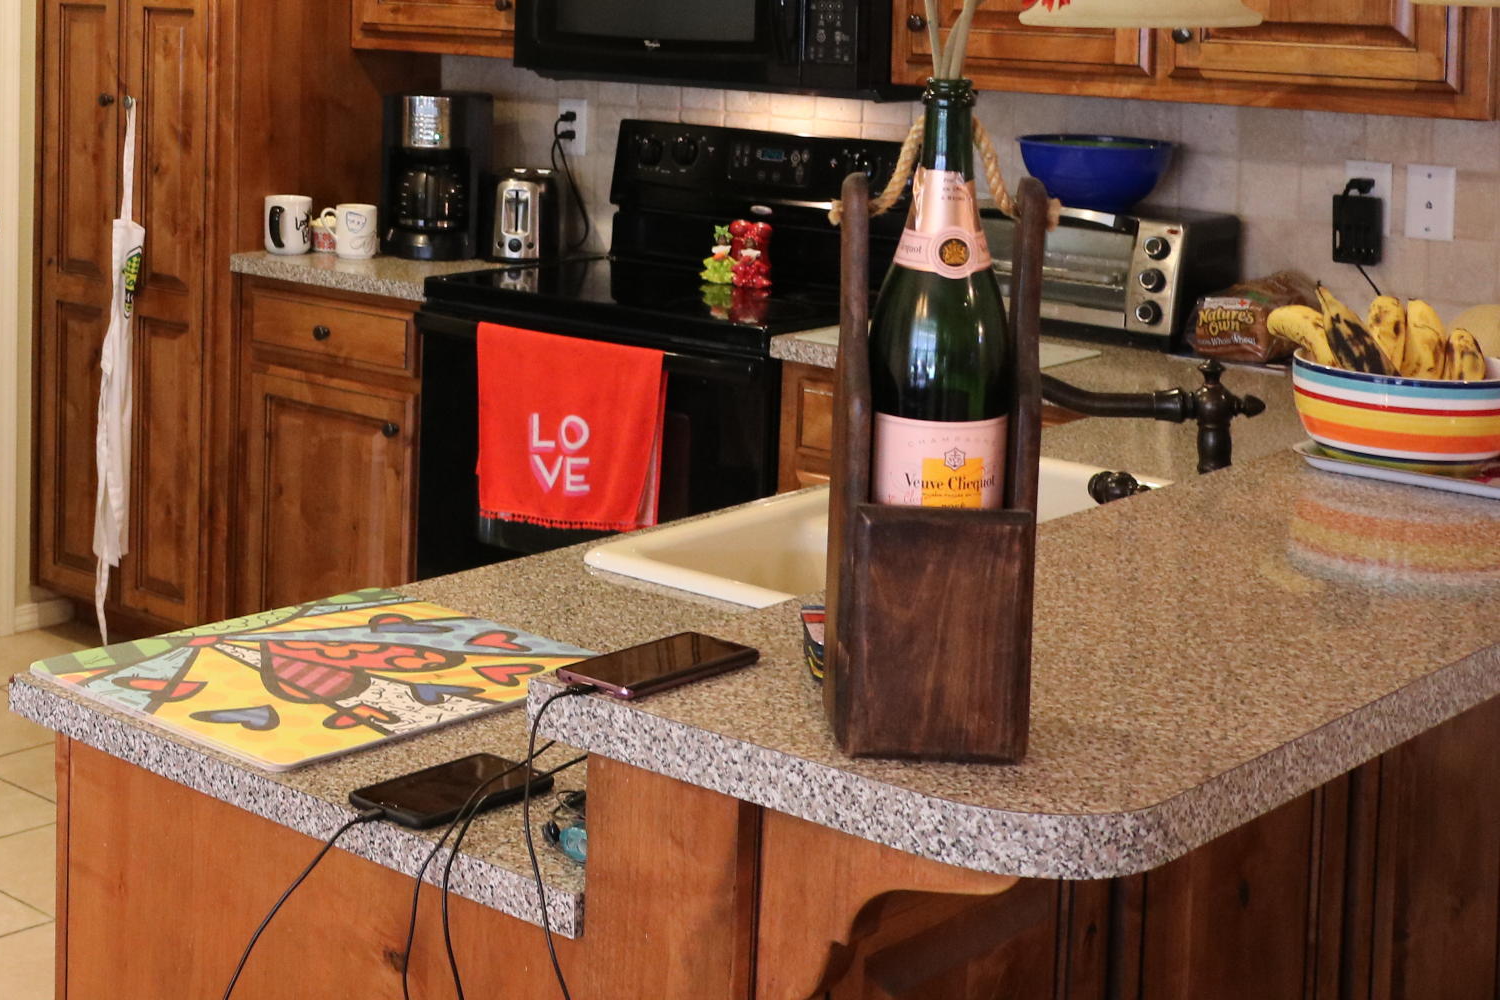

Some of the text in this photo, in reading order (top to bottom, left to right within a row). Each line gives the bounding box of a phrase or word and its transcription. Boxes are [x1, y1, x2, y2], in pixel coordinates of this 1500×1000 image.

[1199, 308, 1254, 326] Nature's
[1209, 320, 1240, 336] Own
[905, 472, 995, 492] Veuve Clicquot
